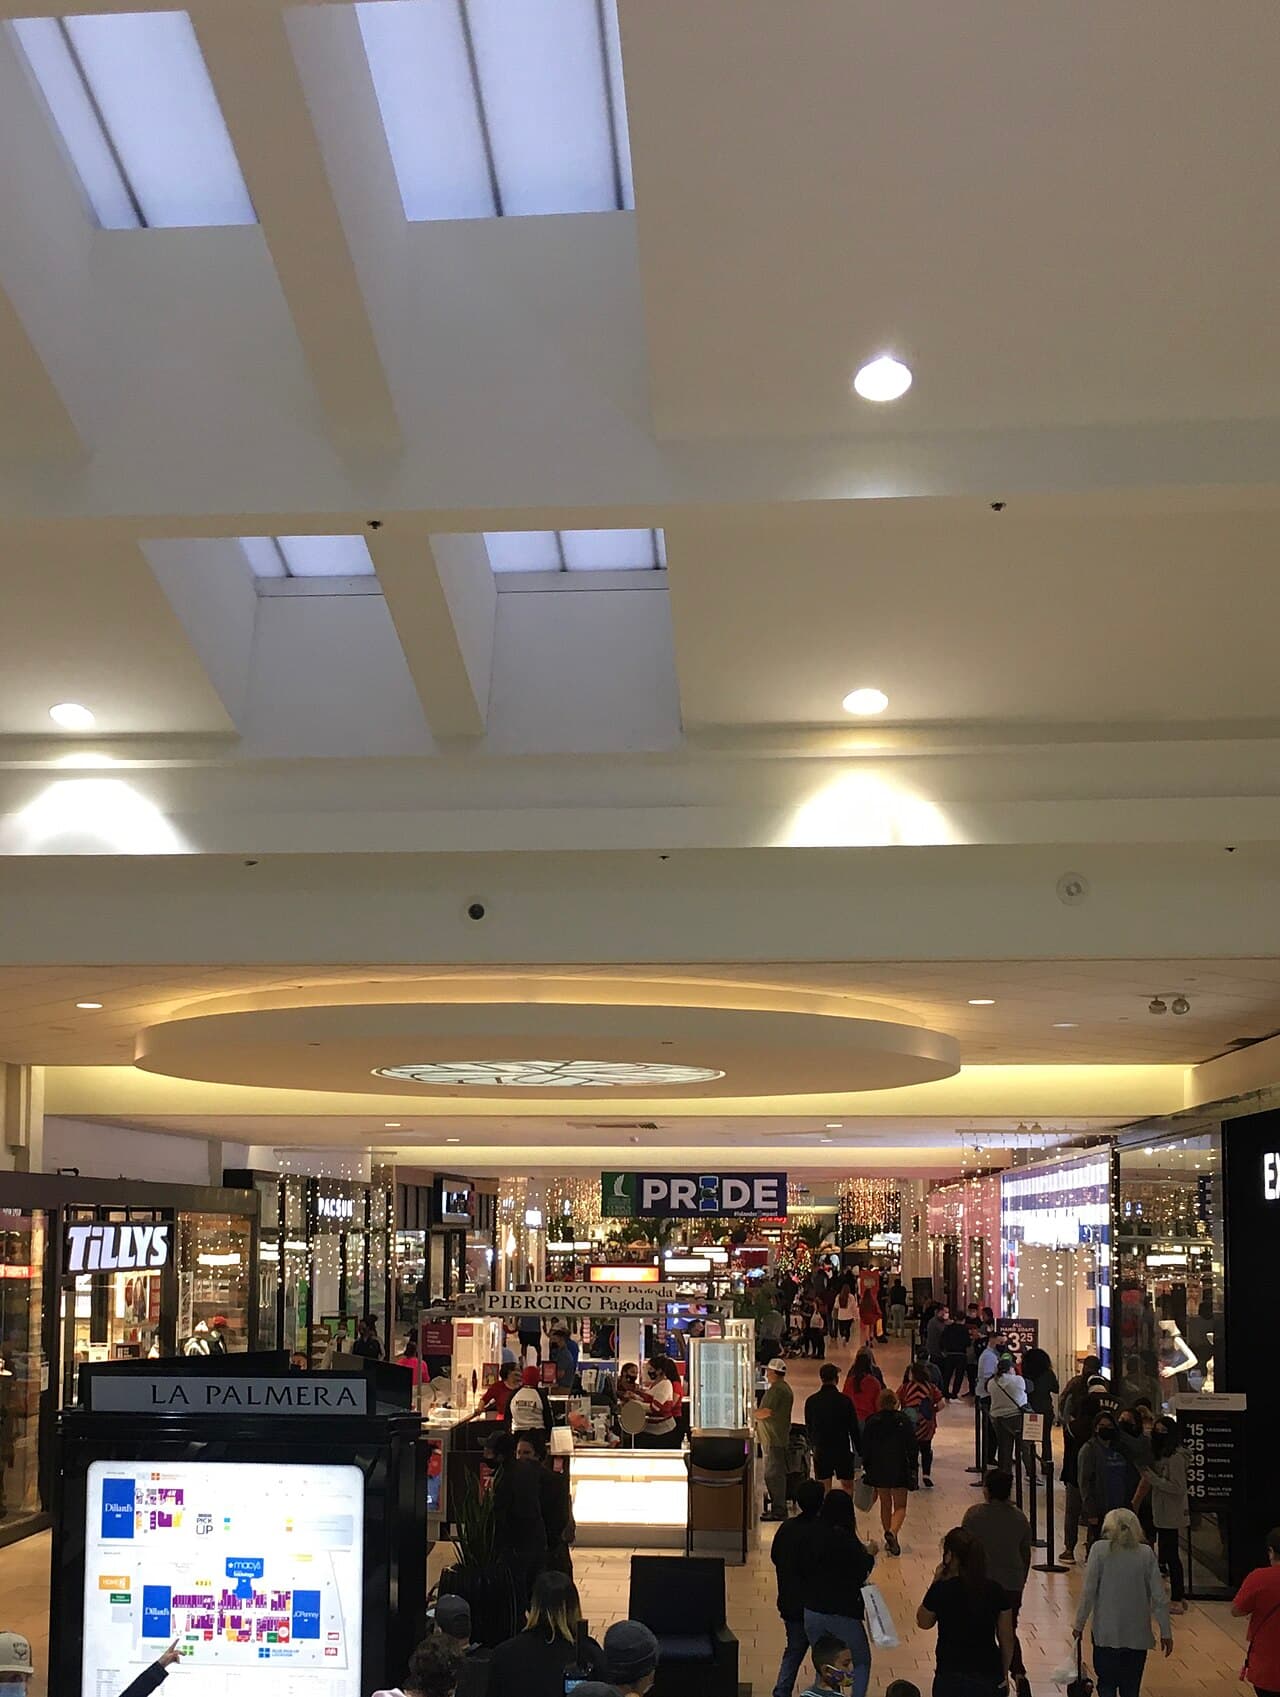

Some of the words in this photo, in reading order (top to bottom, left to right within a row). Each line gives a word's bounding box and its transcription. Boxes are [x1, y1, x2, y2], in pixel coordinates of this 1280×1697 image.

[642, 1175, 778, 1212] PRIDE
[318, 1197, 353, 1218] PACSUN
[488, 1295, 591, 1310] PIERCING
[599, 1296, 653, 1313] Pagoda
[151, 1384, 190, 1405] LA
[206, 1385, 358, 1407] PALMERA
[196, 1524, 214, 1535] UP
